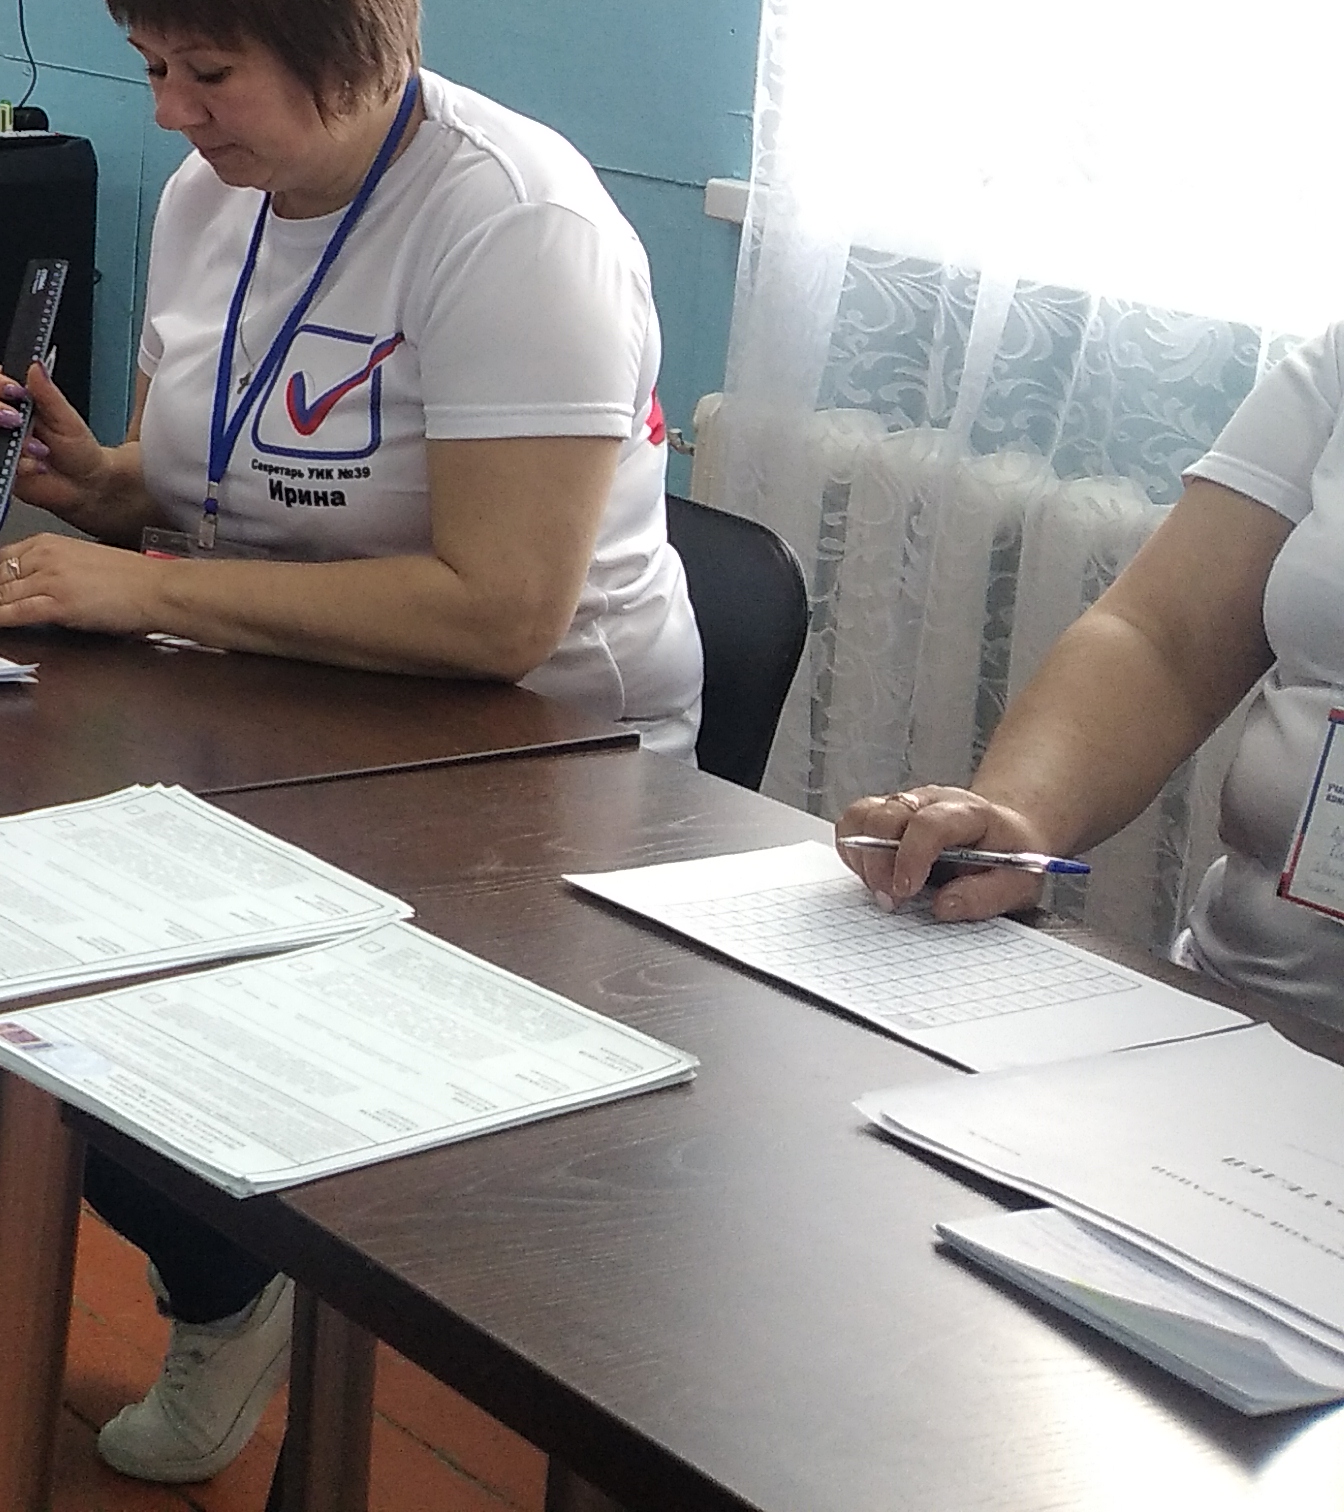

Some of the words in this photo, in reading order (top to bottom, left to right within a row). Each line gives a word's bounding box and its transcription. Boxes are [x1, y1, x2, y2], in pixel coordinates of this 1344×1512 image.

[251, 458, 305, 480] Секретарь
[307, 467, 334, 480] УИК
[337, 467, 371, 479] №39
[268, 478, 347, 508] Ирина
